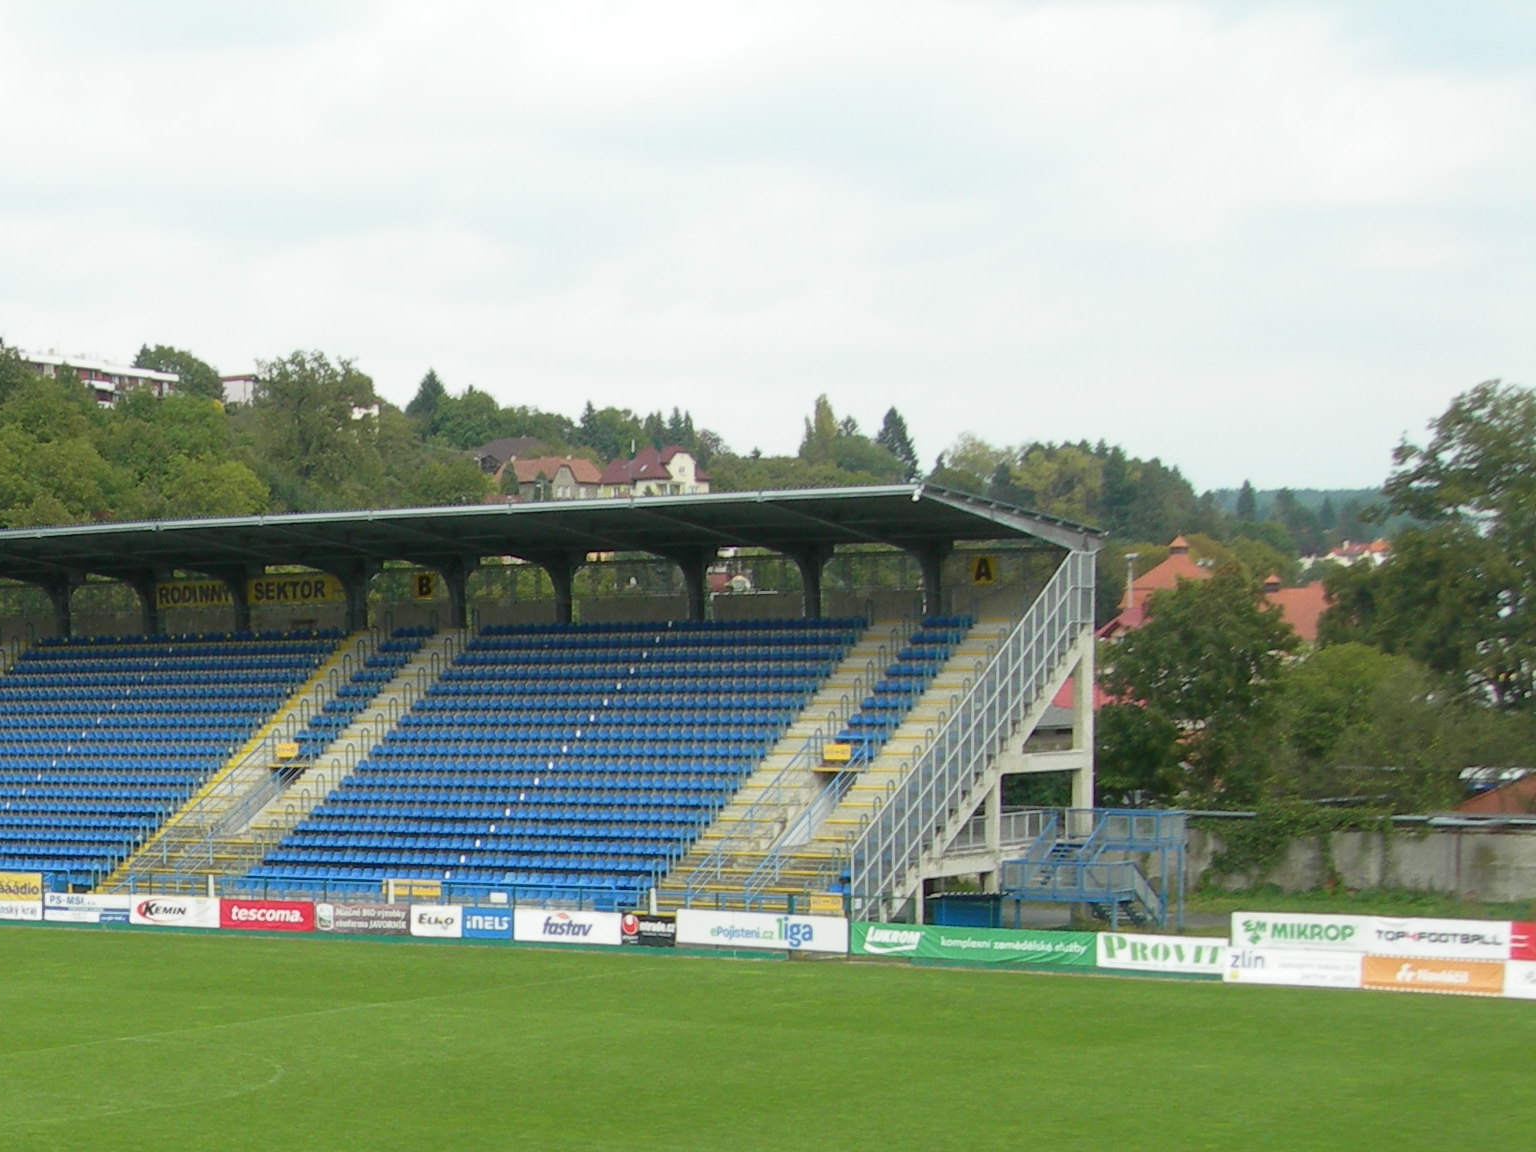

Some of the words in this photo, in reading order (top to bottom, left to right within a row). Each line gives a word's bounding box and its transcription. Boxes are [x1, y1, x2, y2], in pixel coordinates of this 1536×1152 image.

[975, 559, 992, 580] A
[255, 581, 325, 600] SEKTOR
[418, 575, 431, 594] B
[543, 916, 592, 937] fastav
[710, 926, 774, 940] ePojisteni.cz
[865, 926, 920, 944] LUKROM
[1271, 923, 1355, 940] MIKROP
